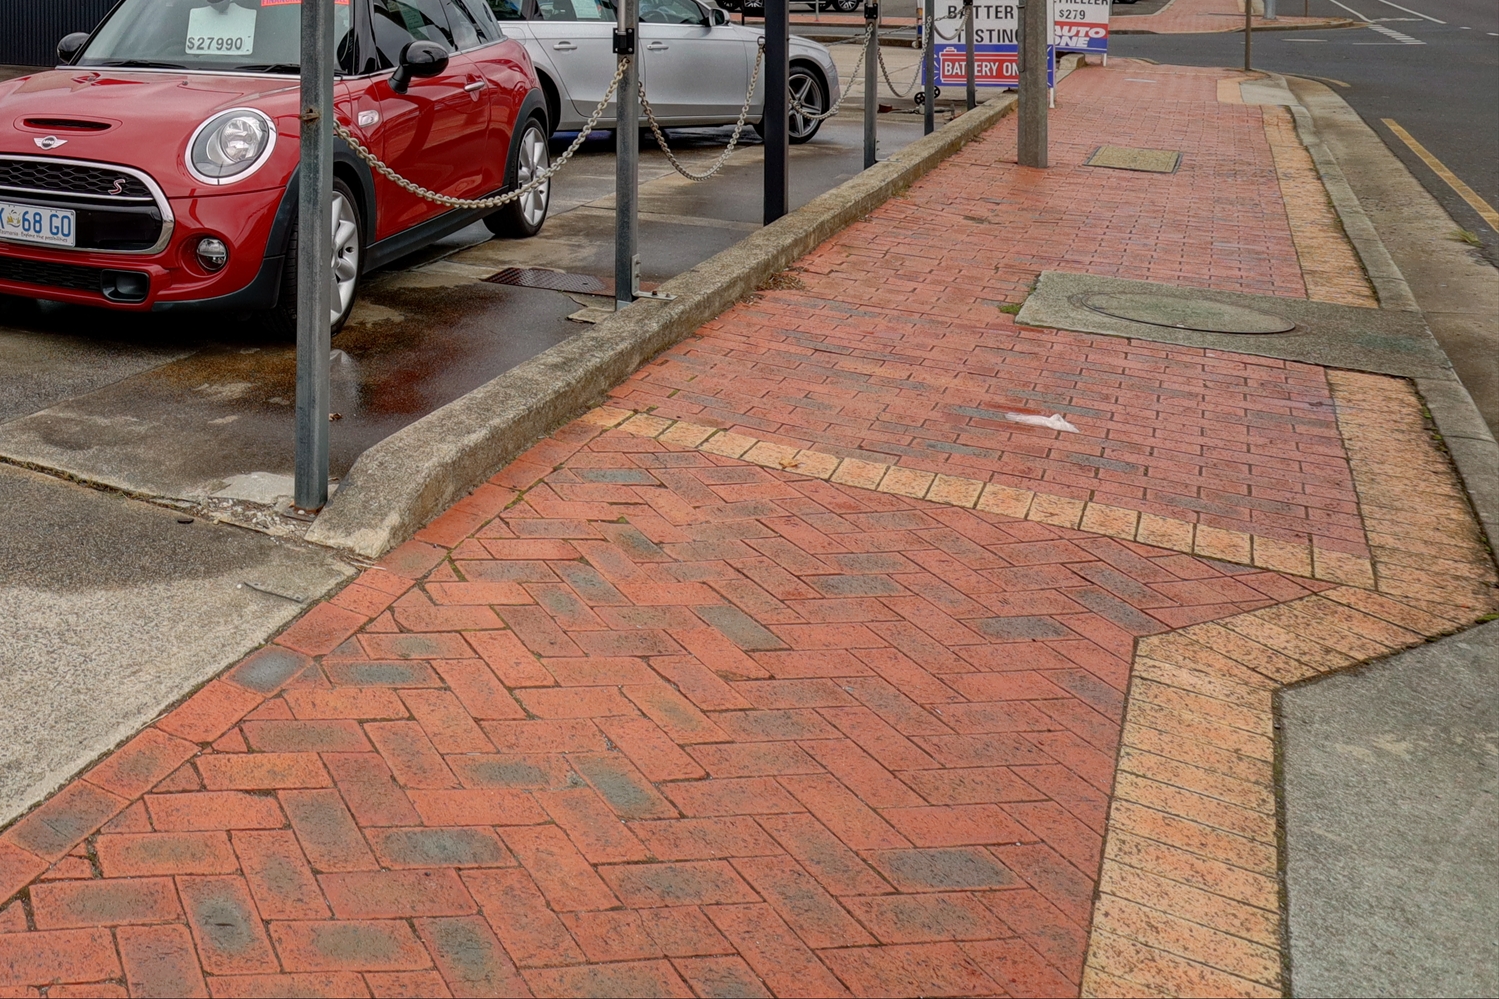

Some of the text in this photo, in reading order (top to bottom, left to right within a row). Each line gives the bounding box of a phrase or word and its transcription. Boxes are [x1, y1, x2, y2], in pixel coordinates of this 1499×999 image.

[1059, 9, 1086, 20] $279
[955, 28, 1020, 43] TSTIN
[1054, 26, 1107, 38] AUTO
[187, 37, 243, 50] $27990
[944, 62, 1019, 76] BATERY ON
[21, 208, 43, 234] 68
[49, 212, 72, 238] GO
[21, 231, 36, 239] Explore
